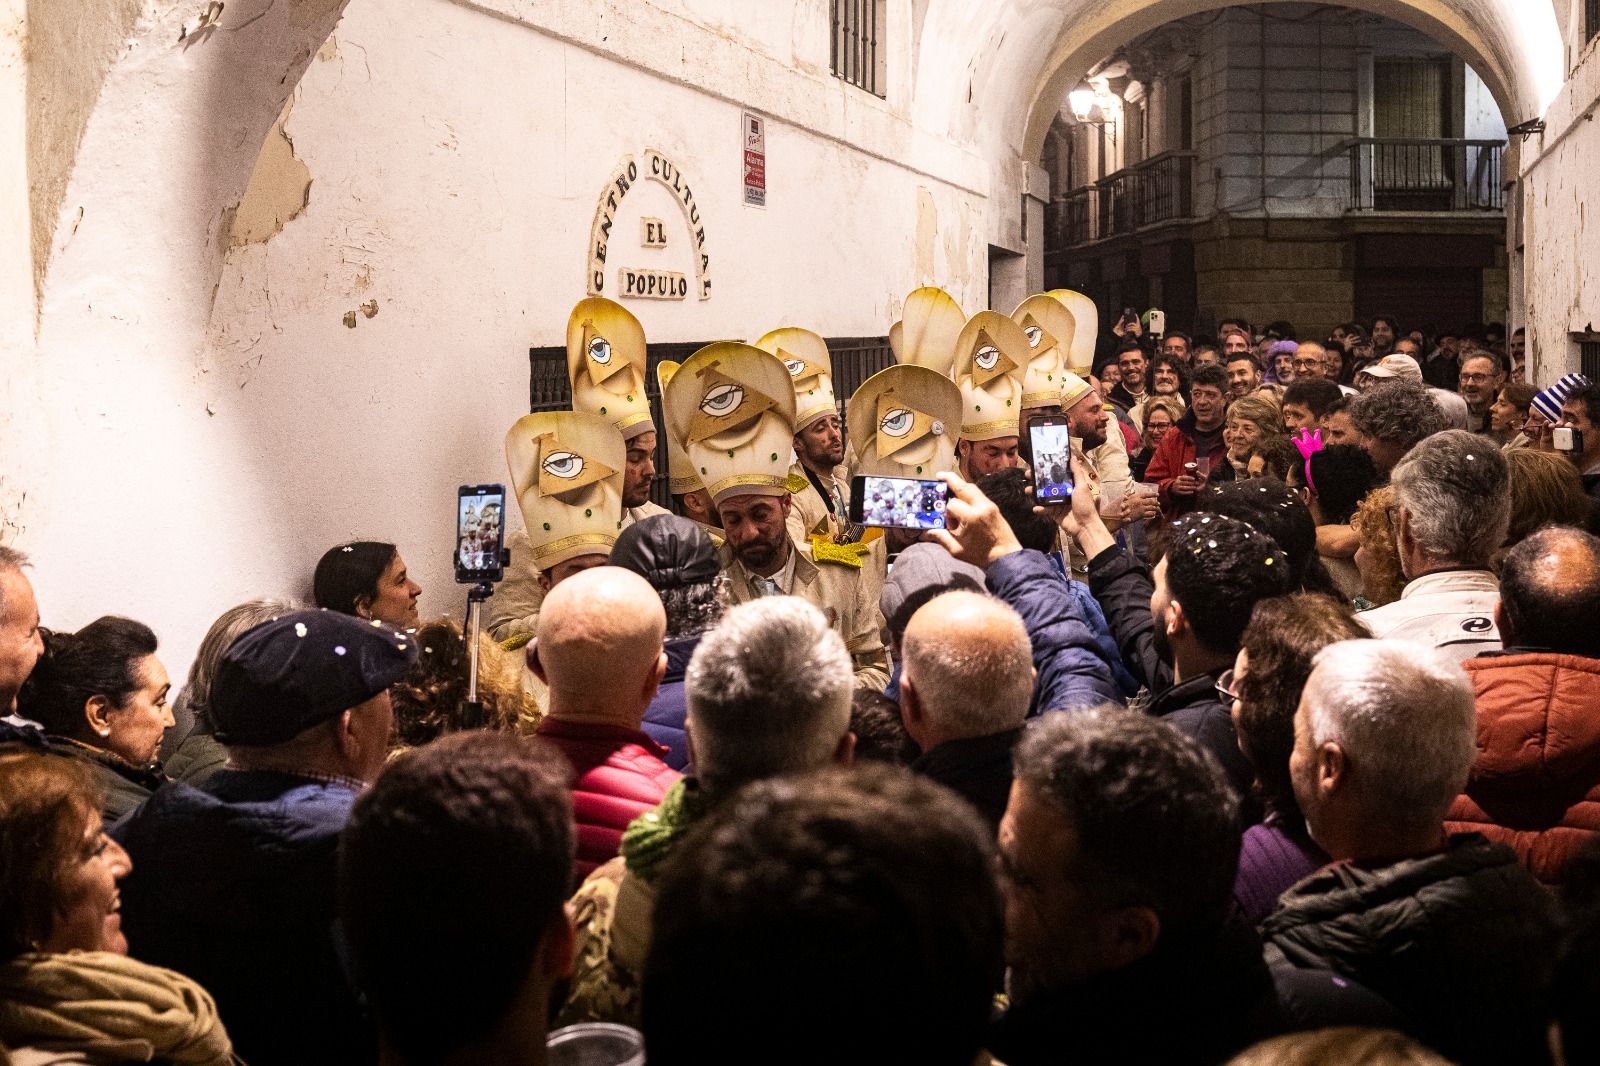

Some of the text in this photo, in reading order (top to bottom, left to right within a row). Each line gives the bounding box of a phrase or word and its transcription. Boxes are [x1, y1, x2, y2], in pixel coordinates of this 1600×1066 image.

[594, 156, 712, 296] CENTRO CULTURAL
[646, 223, 667, 243] EL
[626, 272, 688, 297] POPULO
